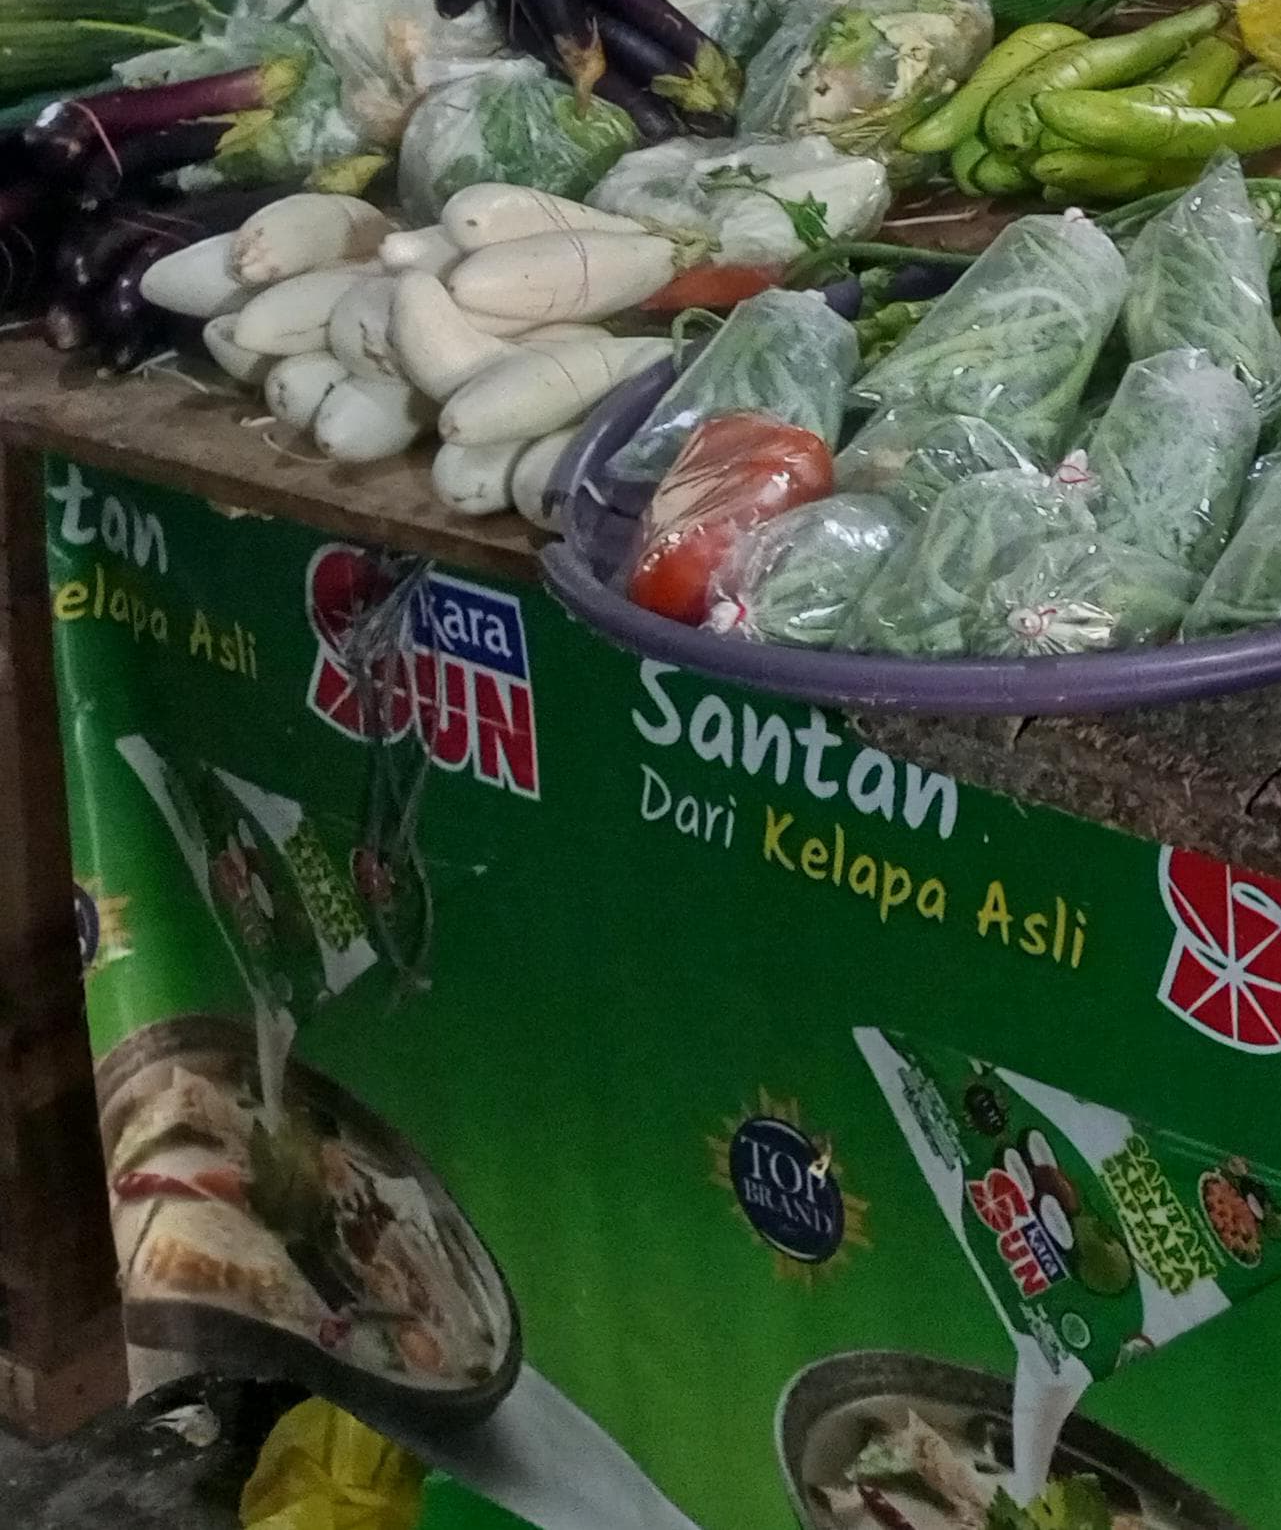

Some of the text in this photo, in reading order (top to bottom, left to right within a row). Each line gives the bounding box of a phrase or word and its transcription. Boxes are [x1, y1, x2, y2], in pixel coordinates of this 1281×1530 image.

[47, 463, 168, 573] tan
[54, 564, 257, 678] elapa Asli
[420, 586, 512, 658] kara
[631, 658, 958, 839] Santan
[640, 764, 1087, 968] Dari Kelapa Asli
[744, 1177, 833, 1234] BRAND
[967, 1169, 1050, 1298] SUN
[1122, 1132, 1219, 1280] SANTAN
